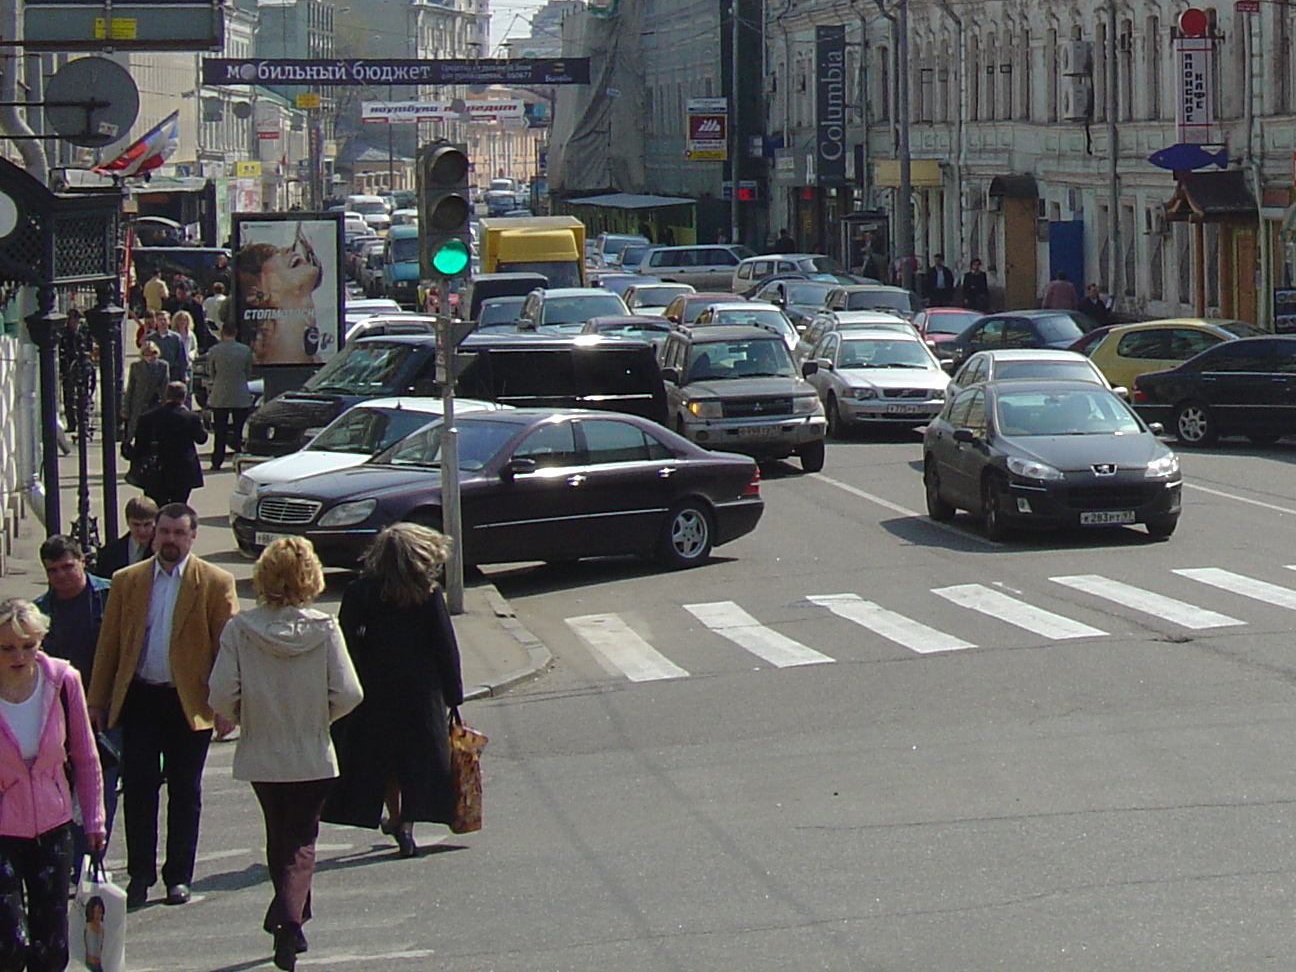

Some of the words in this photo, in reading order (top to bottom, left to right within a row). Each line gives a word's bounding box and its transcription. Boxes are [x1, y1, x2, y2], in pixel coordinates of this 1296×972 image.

[227, 61, 346, 80] мбильный
[1184, 53, 1193, 122] ЯПОНСКОЕ
[456, 103, 518, 113] редит
[820, 50, 844, 161] Columbia
